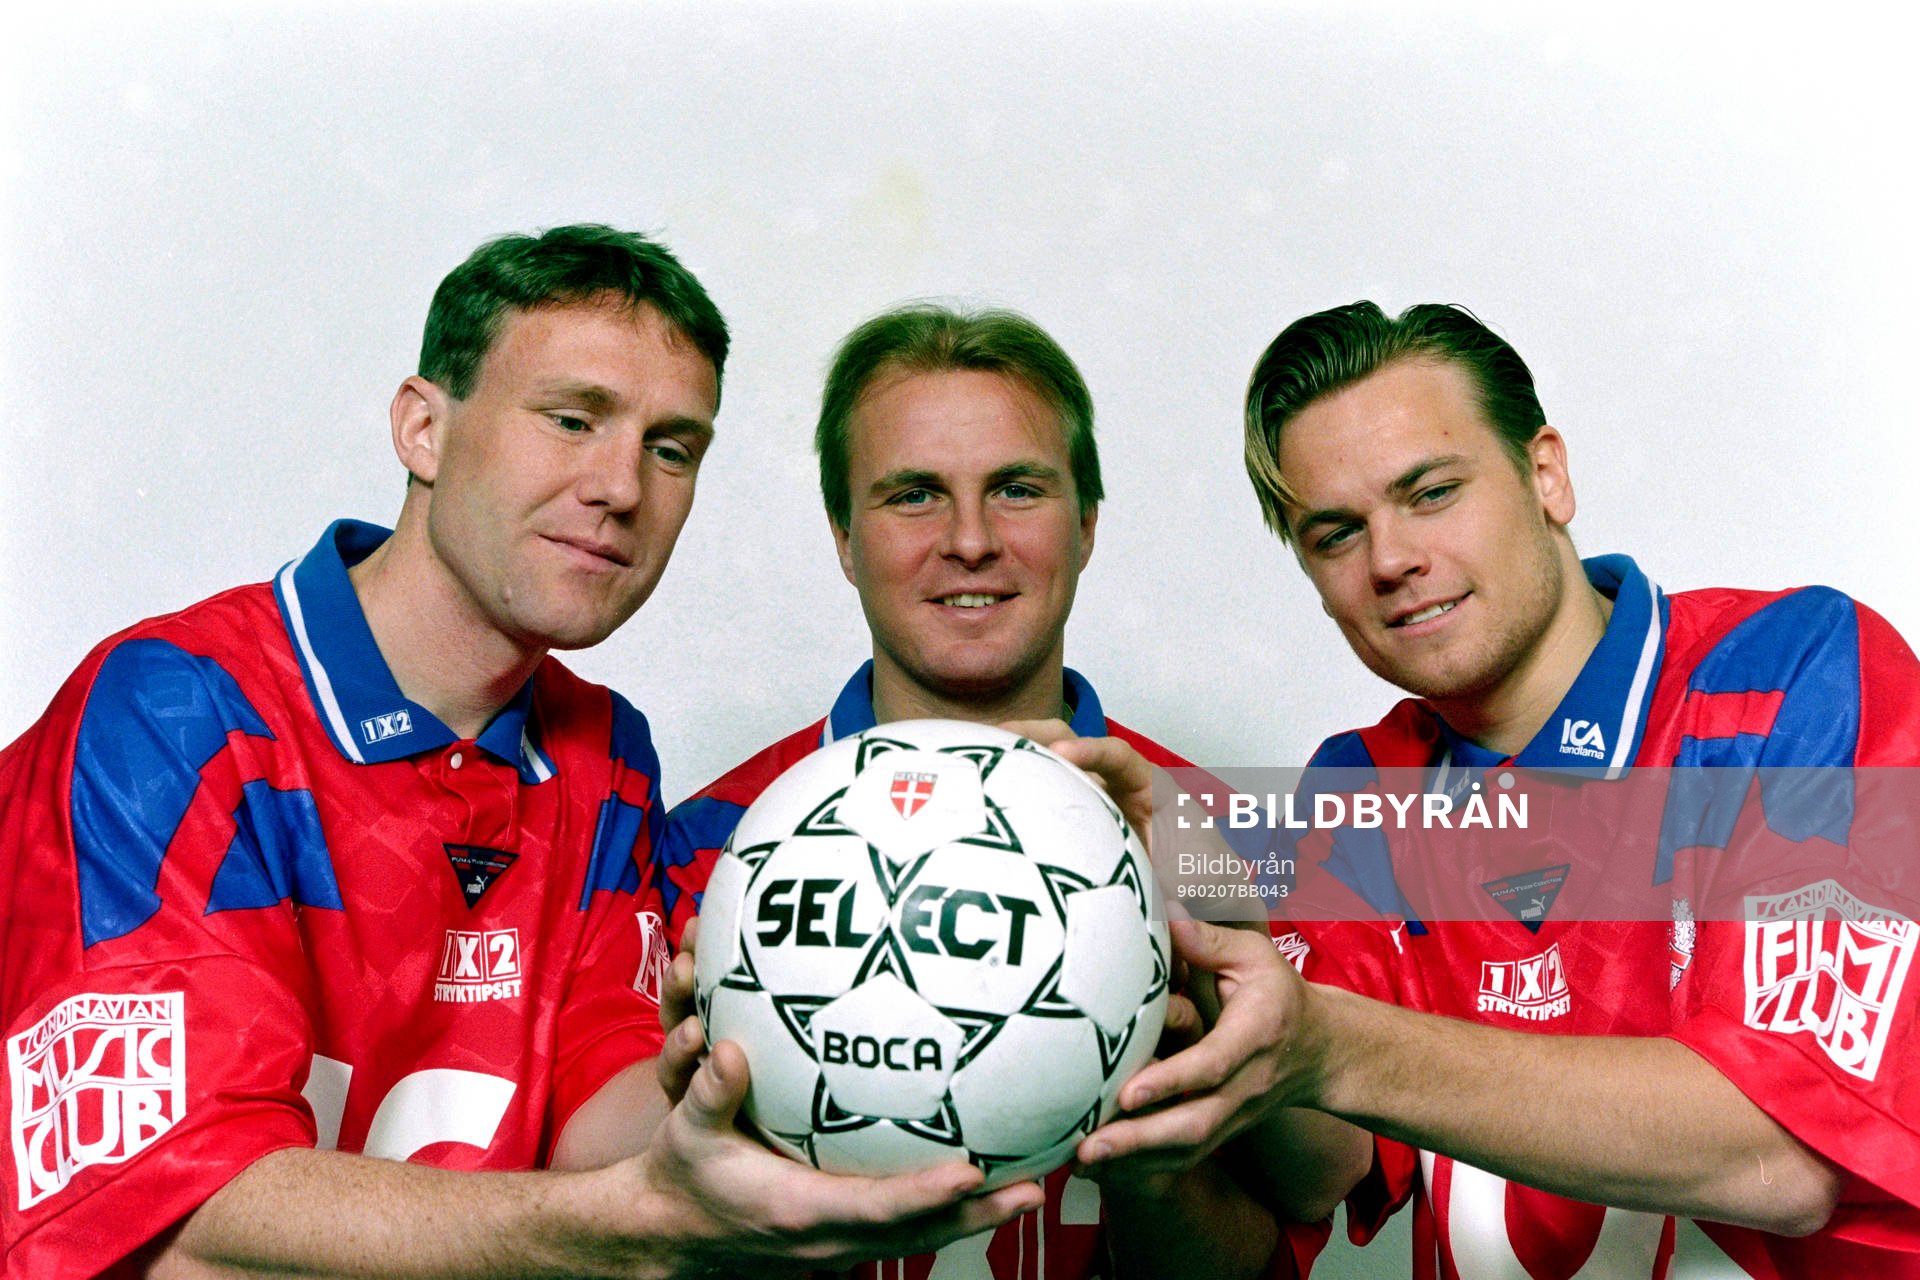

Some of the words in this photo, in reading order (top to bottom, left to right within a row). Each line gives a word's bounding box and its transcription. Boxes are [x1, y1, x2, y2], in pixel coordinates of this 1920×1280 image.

[361, 710, 413, 744] 1X2
[1560, 718, 1606, 751] ICA
[757, 878, 1042, 966] SELECT
[437, 928, 522, 982] 1X2
[1479, 943, 1569, 1004] 1X2
[1761, 906, 1901, 1003] FILM
[434, 979, 523, 1003] STRYKTIPSET
[1477, 994, 1571, 1021] STRYKTIPSET
[823, 1030, 942, 1071] BOCA
